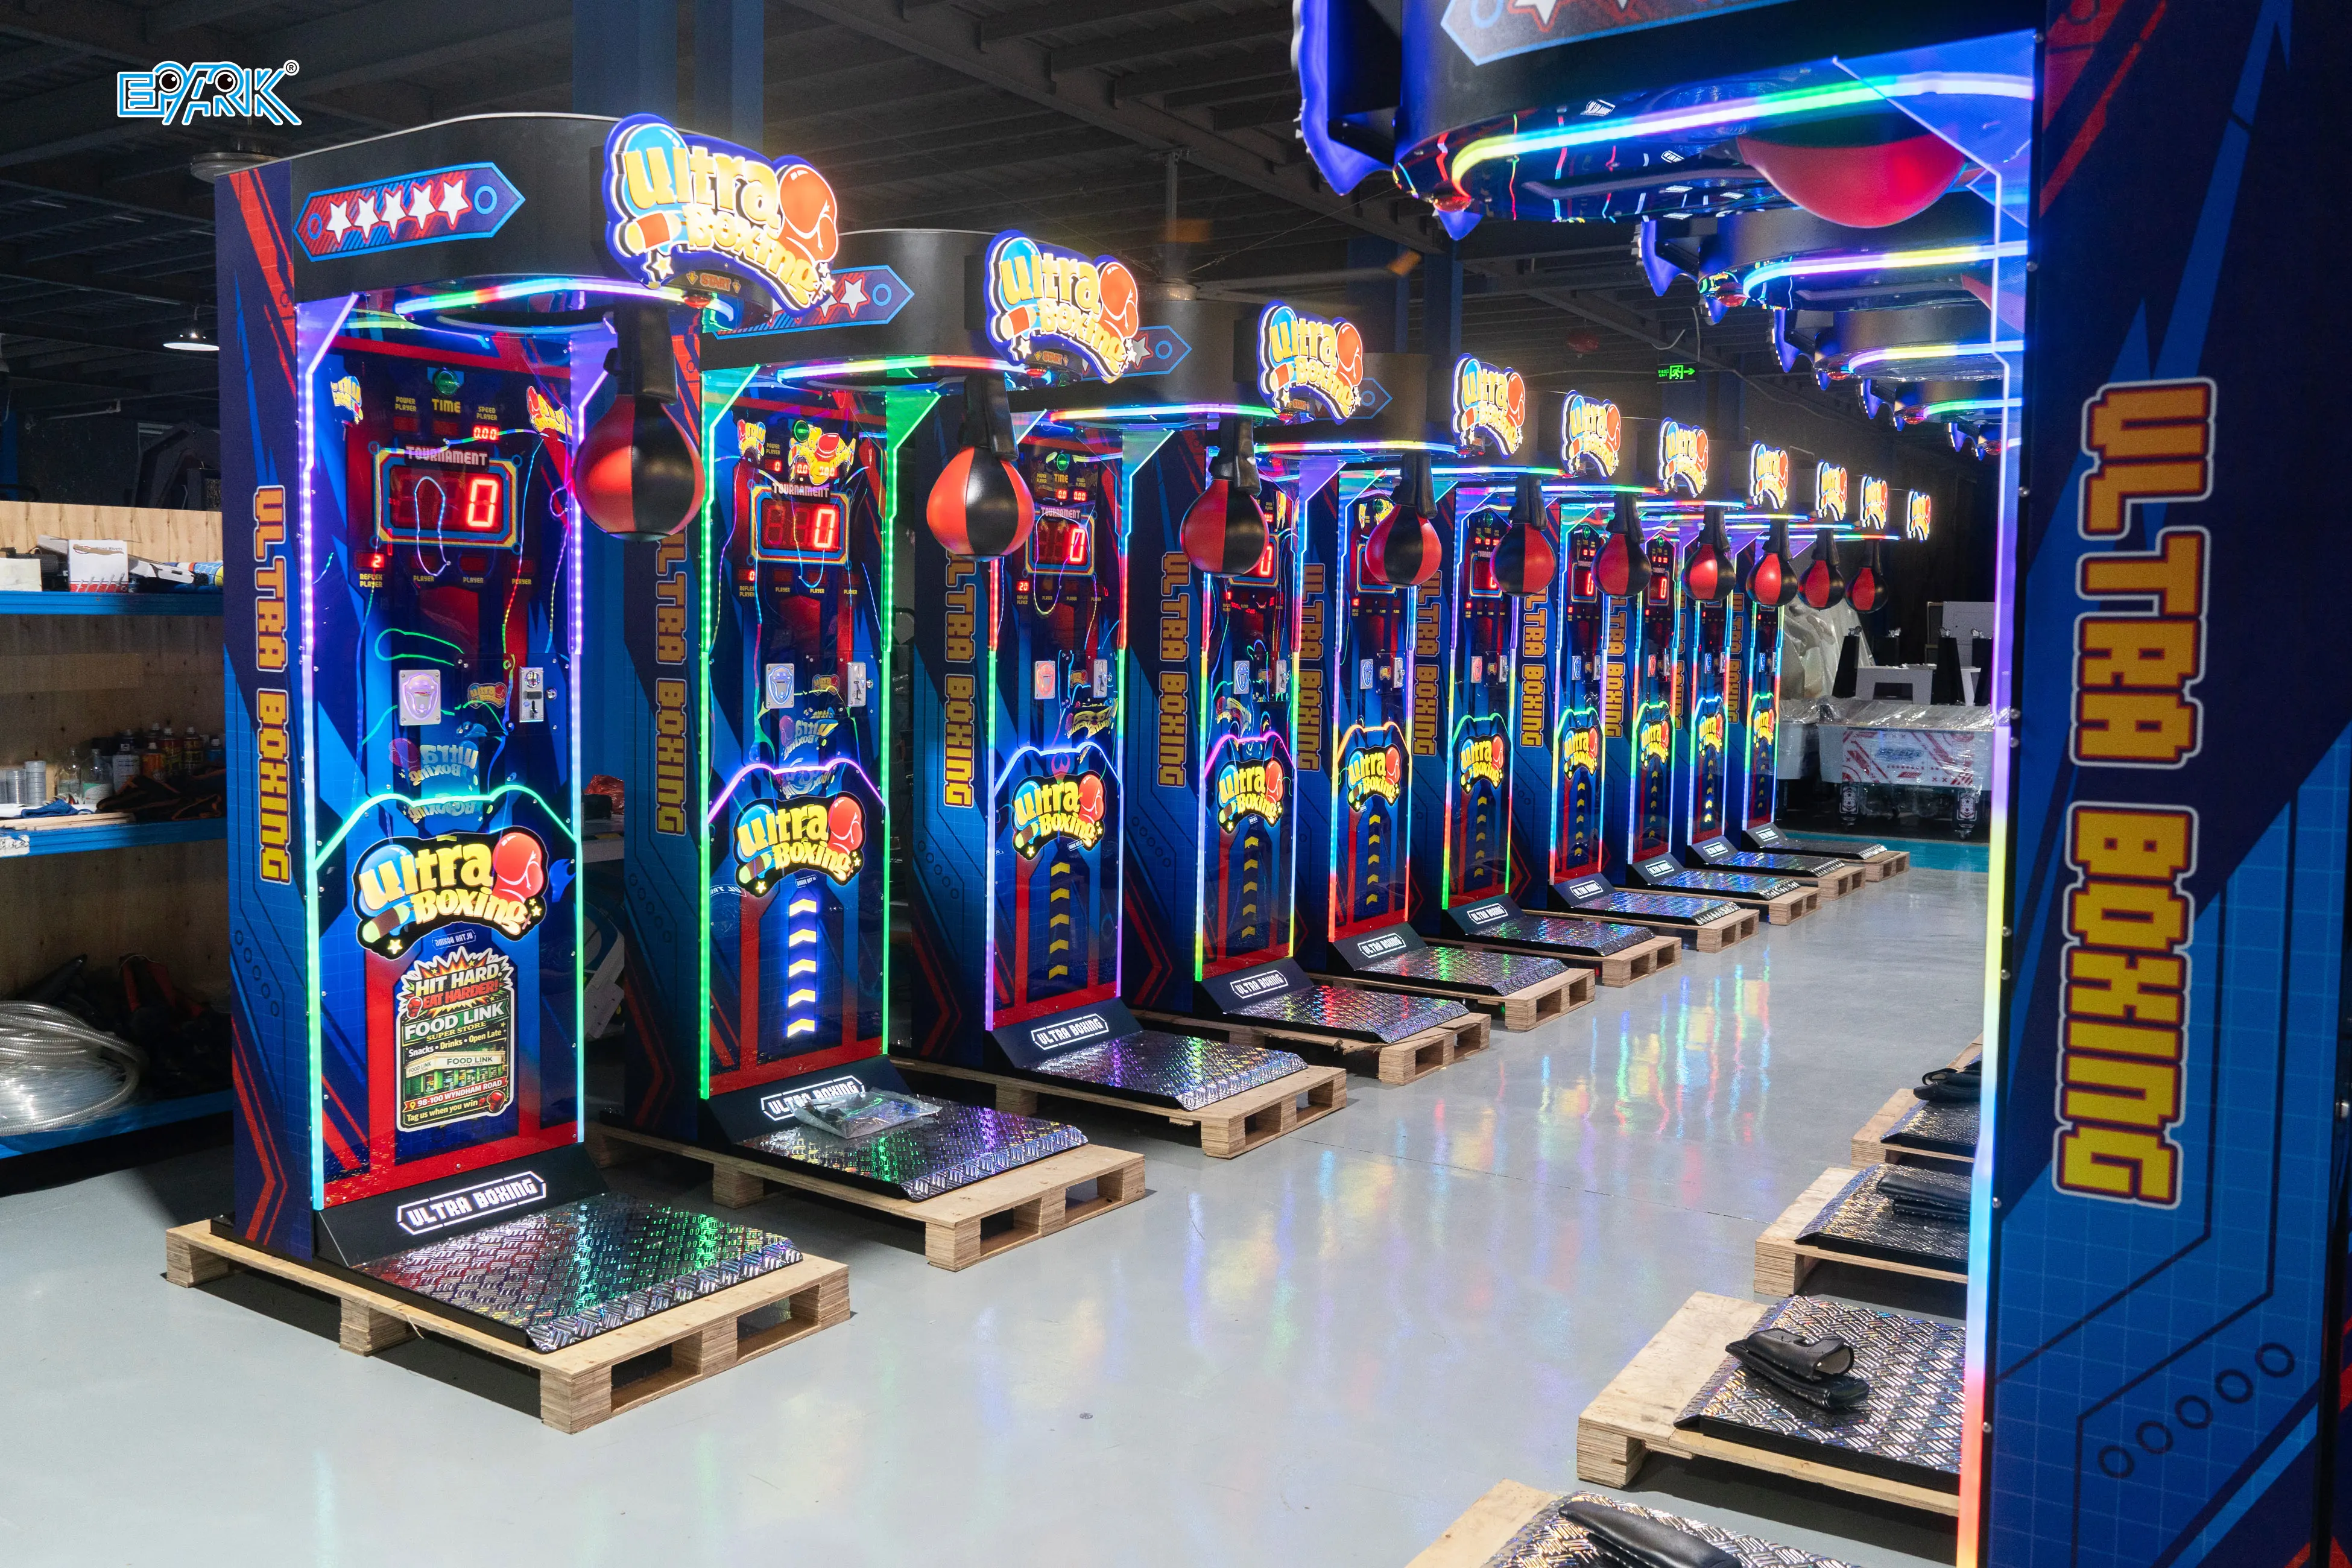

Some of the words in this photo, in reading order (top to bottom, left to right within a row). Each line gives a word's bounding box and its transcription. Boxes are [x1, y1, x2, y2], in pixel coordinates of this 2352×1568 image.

[700, 273, 731, 291] START
[1042, 352, 1063, 364] START
[395, 403, 417, 412] PLAYER
[396, 396, 416, 405] POWER
[432, 399, 461, 414] TIME
[476, 412, 498, 420] PLAYER
[405, 445, 488, 466] TOURNAMENT
[772, 482, 829, 498] TOURNAMENT
[1054, 473, 1068, 483] TIME
[467, 479, 498, 528] 0
[1041, 507, 1081, 519] TOURNAMENT
[814, 508, 836, 549] 0
[1070, 528, 1086, 563] 0
[373, 555, 381, 569] 2
[2069, 377, 2217, 769] ULTRA
[253, 485, 286, 672] ULTRA
[1018, 582, 1029, 591] 20
[1661, 578, 1667, 598] 0
[946, 551, 976, 662] LTRA
[1160, 551, 1190, 661] ULTRA
[1523, 587, 1548, 657] LTRA
[1412, 664, 1440, 757] BOXING
[1520, 664, 1546, 747] BOXING
[1157, 671, 1188, 788] BOXING
[1297, 669, 1323, 772] BOXING
[945, 674, 975, 808] BOXING
[656, 678, 687, 836] BOXING
[257, 688, 292, 885] BOXING
[1362, 941, 1382, 955] ULTRA
[416, 976, 447, 997] HIT
[450, 963, 503, 990] HARD.
[423, 995, 443, 1009] EAT
[445, 979, 499, 1005] HARDER!
[1234, 980, 1259, 996] ULTRA
[1257, 973, 1283, 989] BOXING
[2051, 800, 2199, 1209] BOXING
[405, 1014, 458, 1040] FOOD
[463, 1002, 505, 1025] LINK
[426, 1030, 456, 1042] SUPER
[457, 1020, 487, 1033] STORE
[1037, 1026, 1072, 1046] ULTRA
[1070, 1017, 1104, 1035] BOXING
[408, 1046, 434, 1058] Snacks
[440, 1038, 463, 1049] Drinks
[469, 1032, 486, 1043] Open
[487, 1029, 502, 1039] Late
[409, 1064, 421, 1073] FOOD
[417, 1095, 444, 1108] 98-100
[444, 1085, 482, 1101] WYNDHAM
[483, 1079, 502, 1090] ROAD
[406, 1113, 419, 1122] Tag
[429, 1106, 449, 1116] when
[449, 1102, 463, 1113] you
[463, 1099, 479, 1108] win
[406, 1195, 473, 1227] ULTRA
[477, 1177, 536, 1209] BOXING
